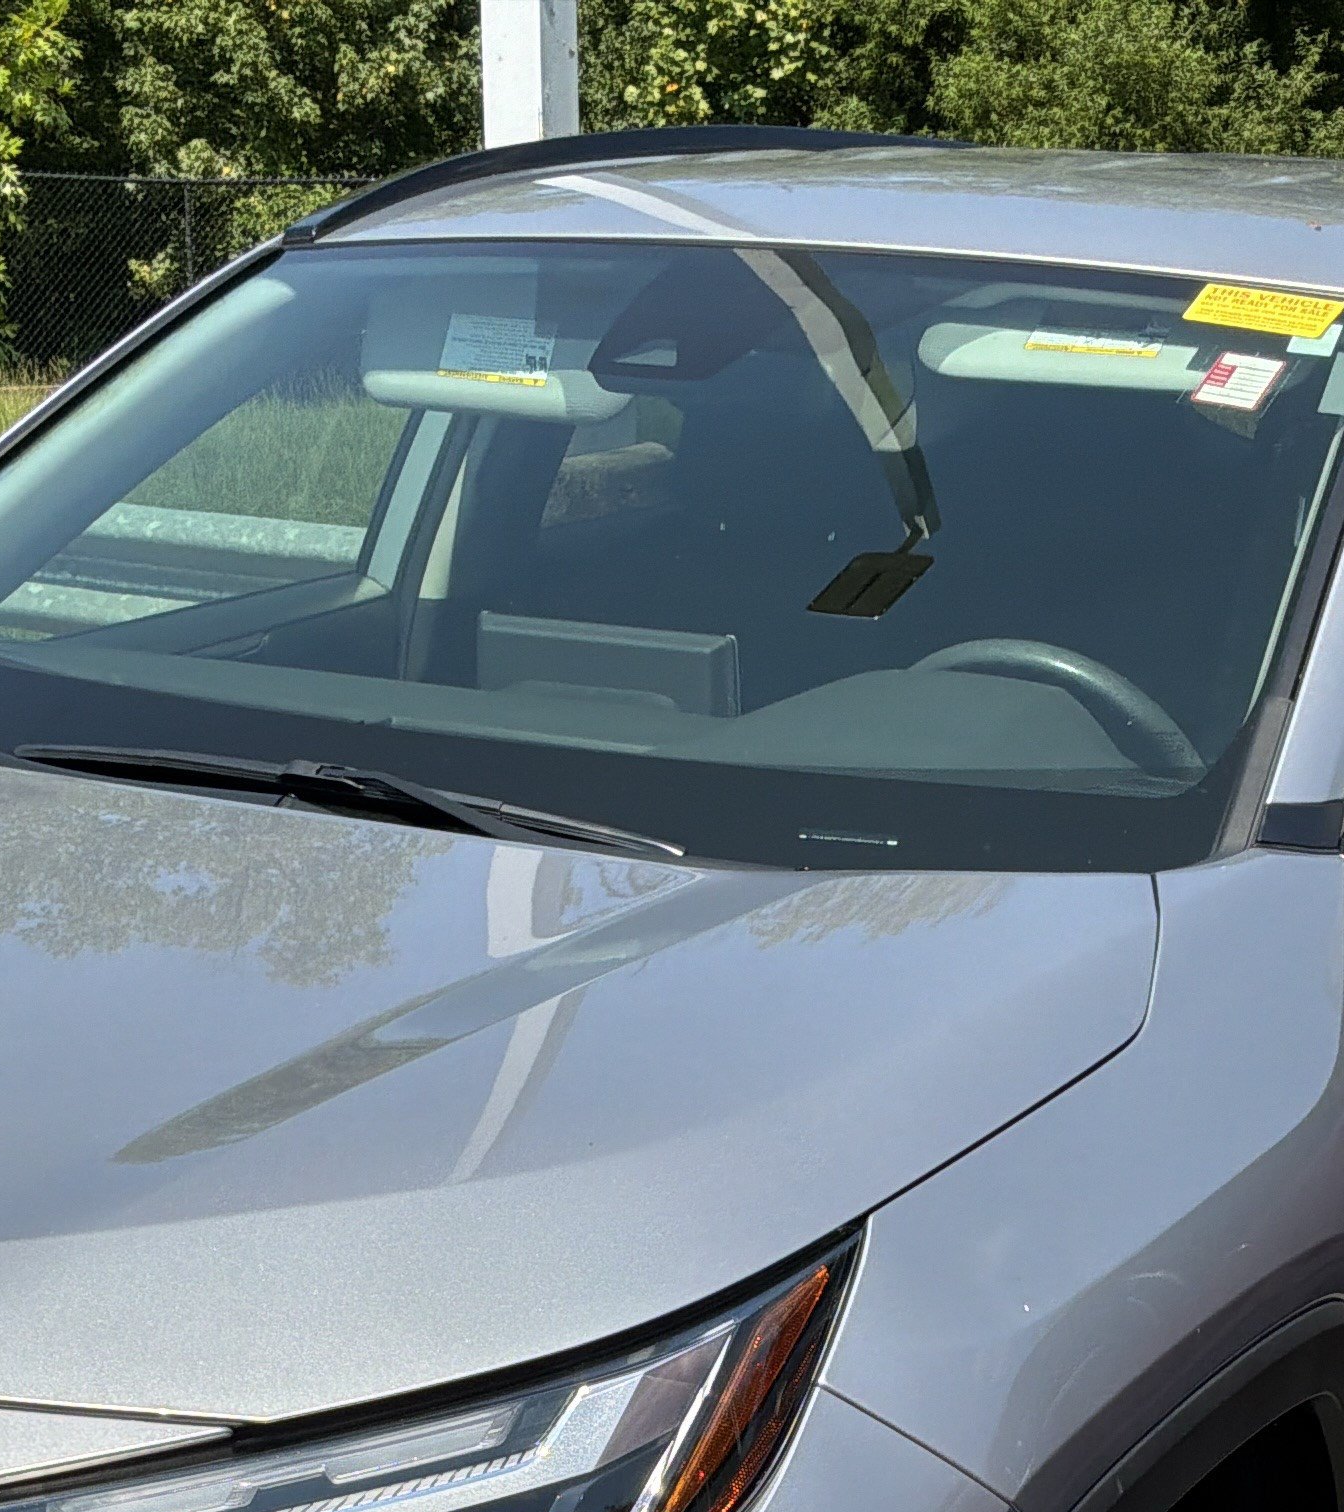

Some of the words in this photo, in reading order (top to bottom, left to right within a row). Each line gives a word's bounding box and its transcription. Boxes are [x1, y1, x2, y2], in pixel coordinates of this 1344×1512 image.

[1210, 287, 1252, 299] THIS
[1259, 293, 1336, 311] VEHICLE
[1300, 307, 1331, 317] SALE
